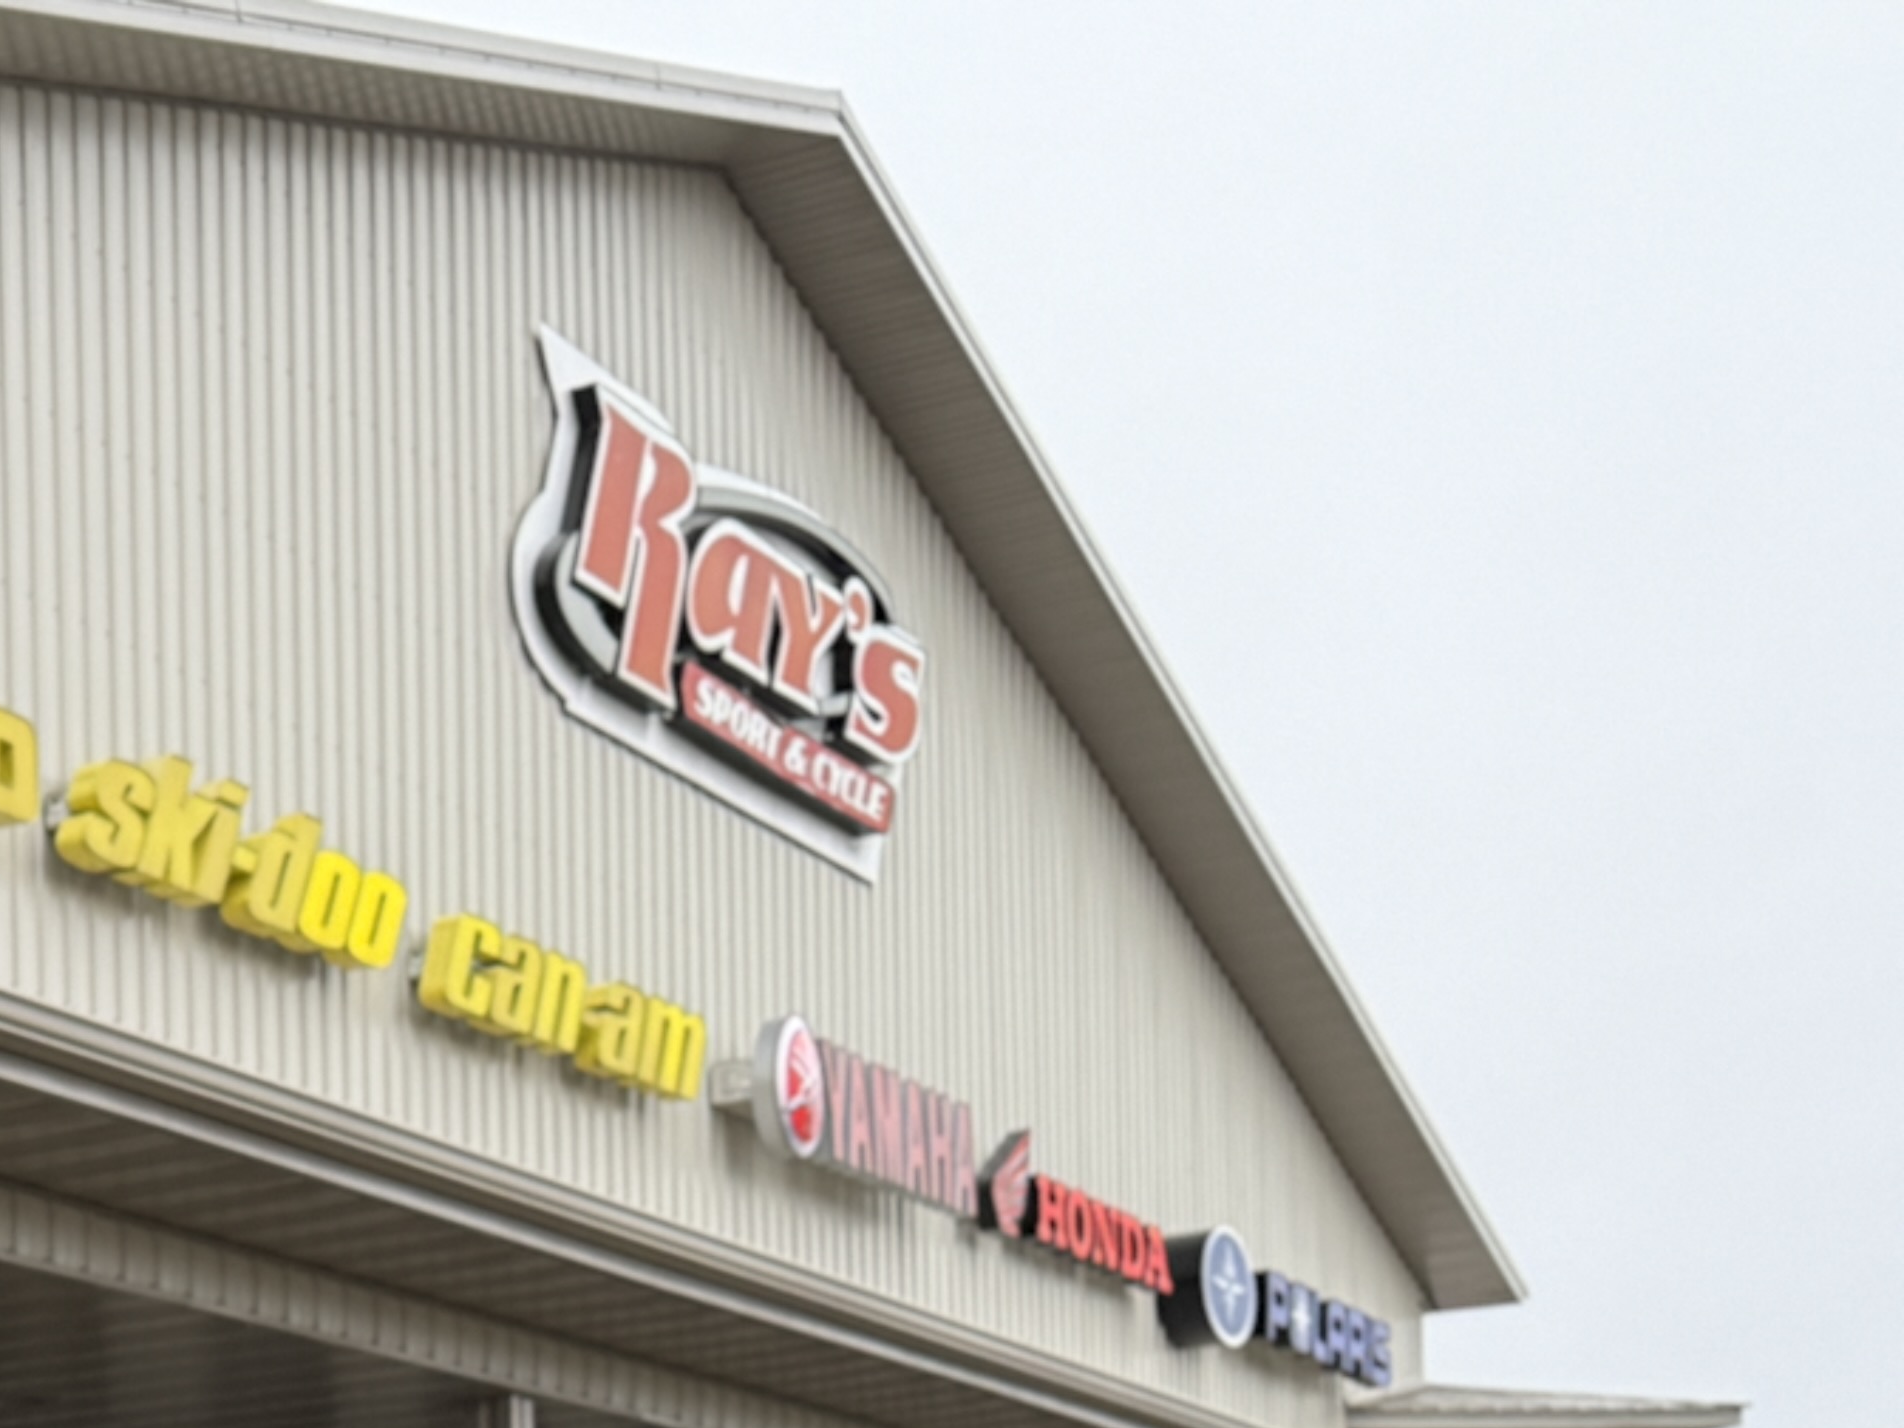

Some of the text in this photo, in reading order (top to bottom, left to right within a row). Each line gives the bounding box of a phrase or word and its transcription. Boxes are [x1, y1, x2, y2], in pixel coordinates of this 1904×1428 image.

[692, 675, 891, 821] SPORT & CYCLE
[821, 1039, 979, 1216] YAMAHA
[1036, 1174, 1174, 1296] HONDA
[1265, 1271, 1392, 1388] POLARIS
